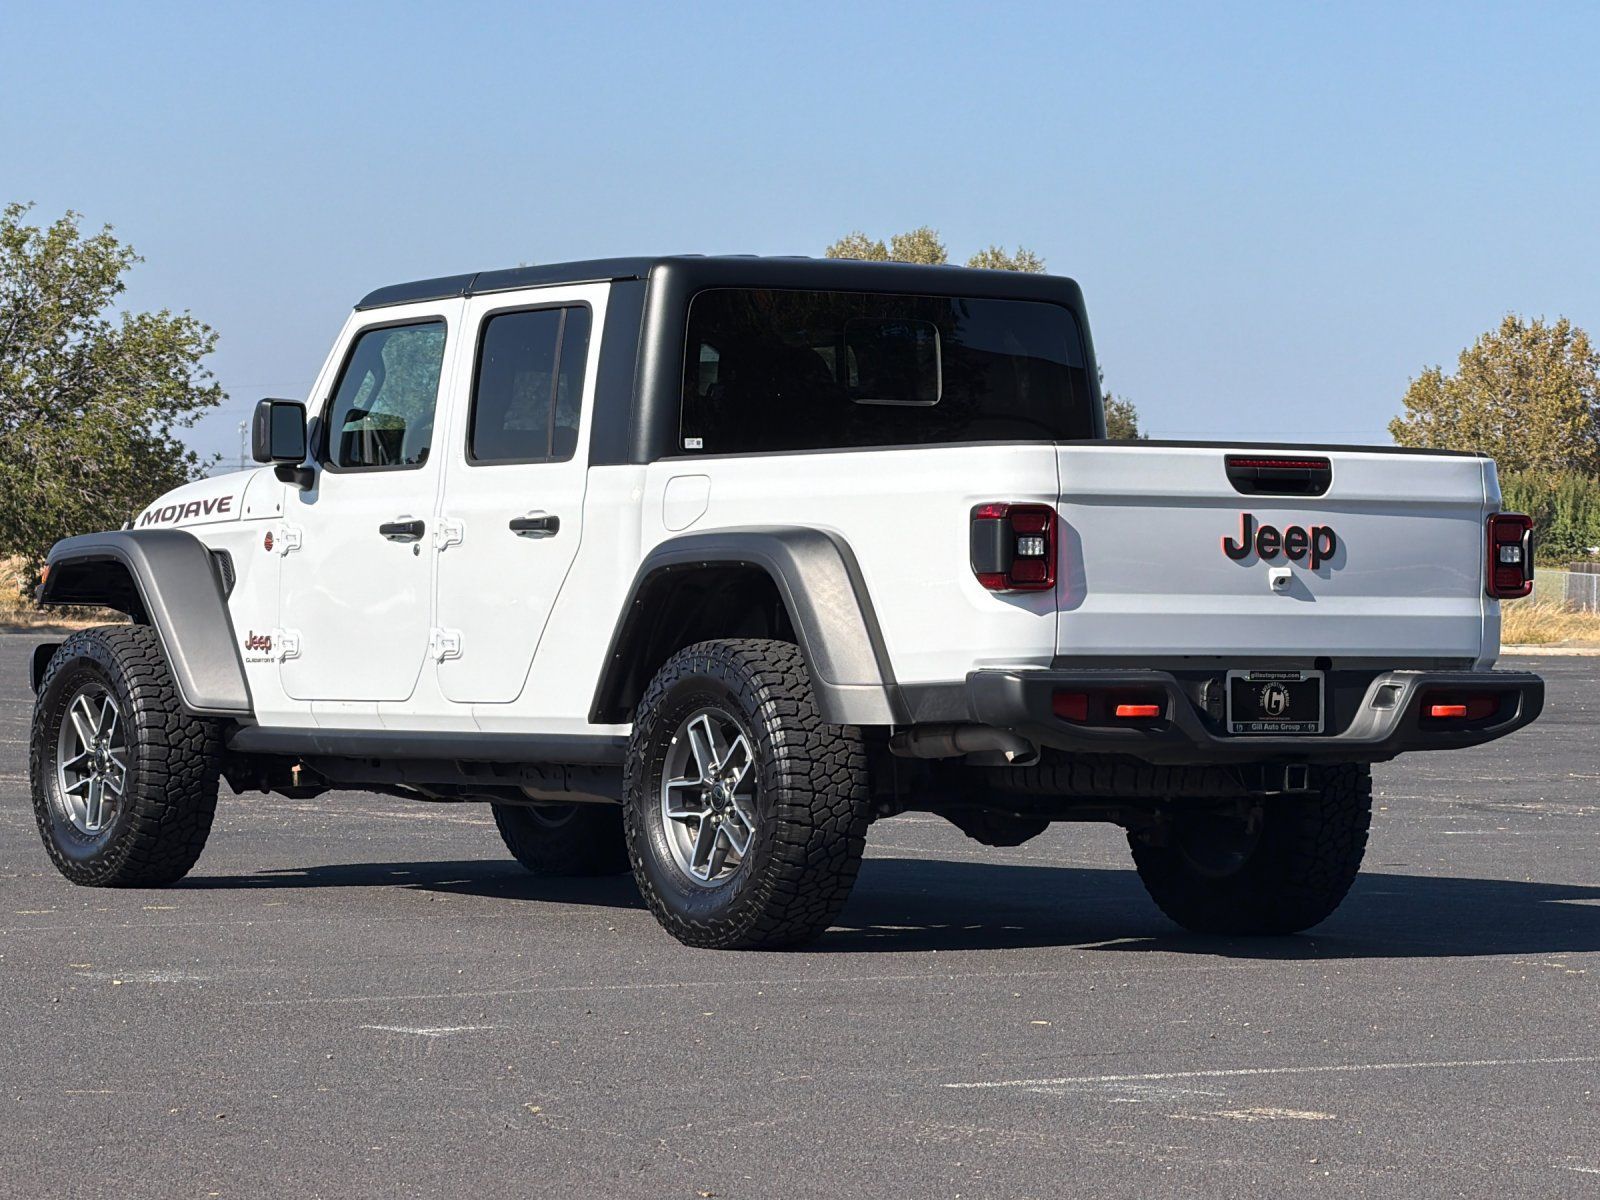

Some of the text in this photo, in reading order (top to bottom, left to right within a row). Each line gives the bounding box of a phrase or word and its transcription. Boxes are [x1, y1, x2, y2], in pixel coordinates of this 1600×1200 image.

[140, 495, 234, 527] MOJAVE
[1220, 512, 1337, 570] Jeep
[244, 629, 272, 655] Jeep
[1280, 723, 1300, 731] Group
